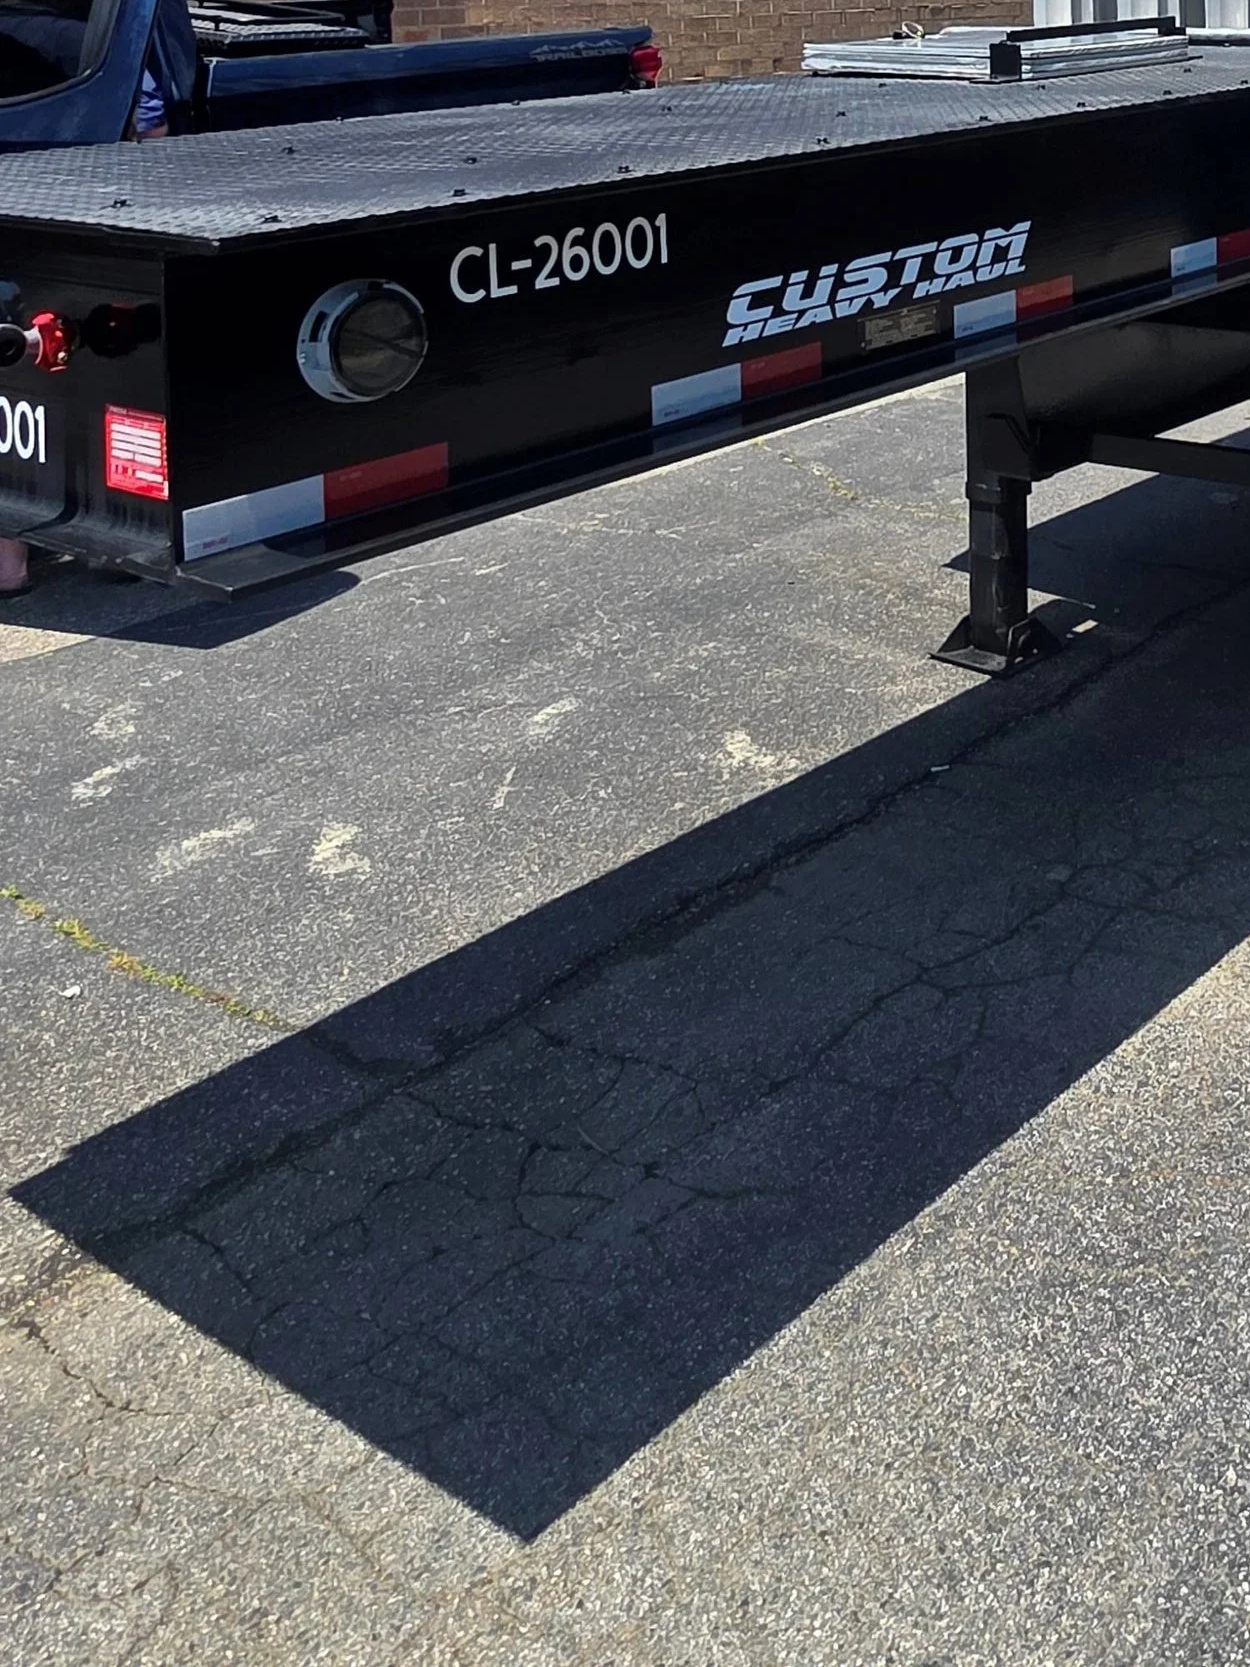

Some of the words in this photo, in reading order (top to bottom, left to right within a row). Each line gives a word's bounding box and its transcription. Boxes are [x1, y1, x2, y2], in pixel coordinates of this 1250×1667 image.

[450, 213, 668, 303] CL-26001
[721, 286, 903, 348] HEAVY
[912, 256, 1027, 299] HAUL
[726, 220, 1032, 326] CUSTOM
